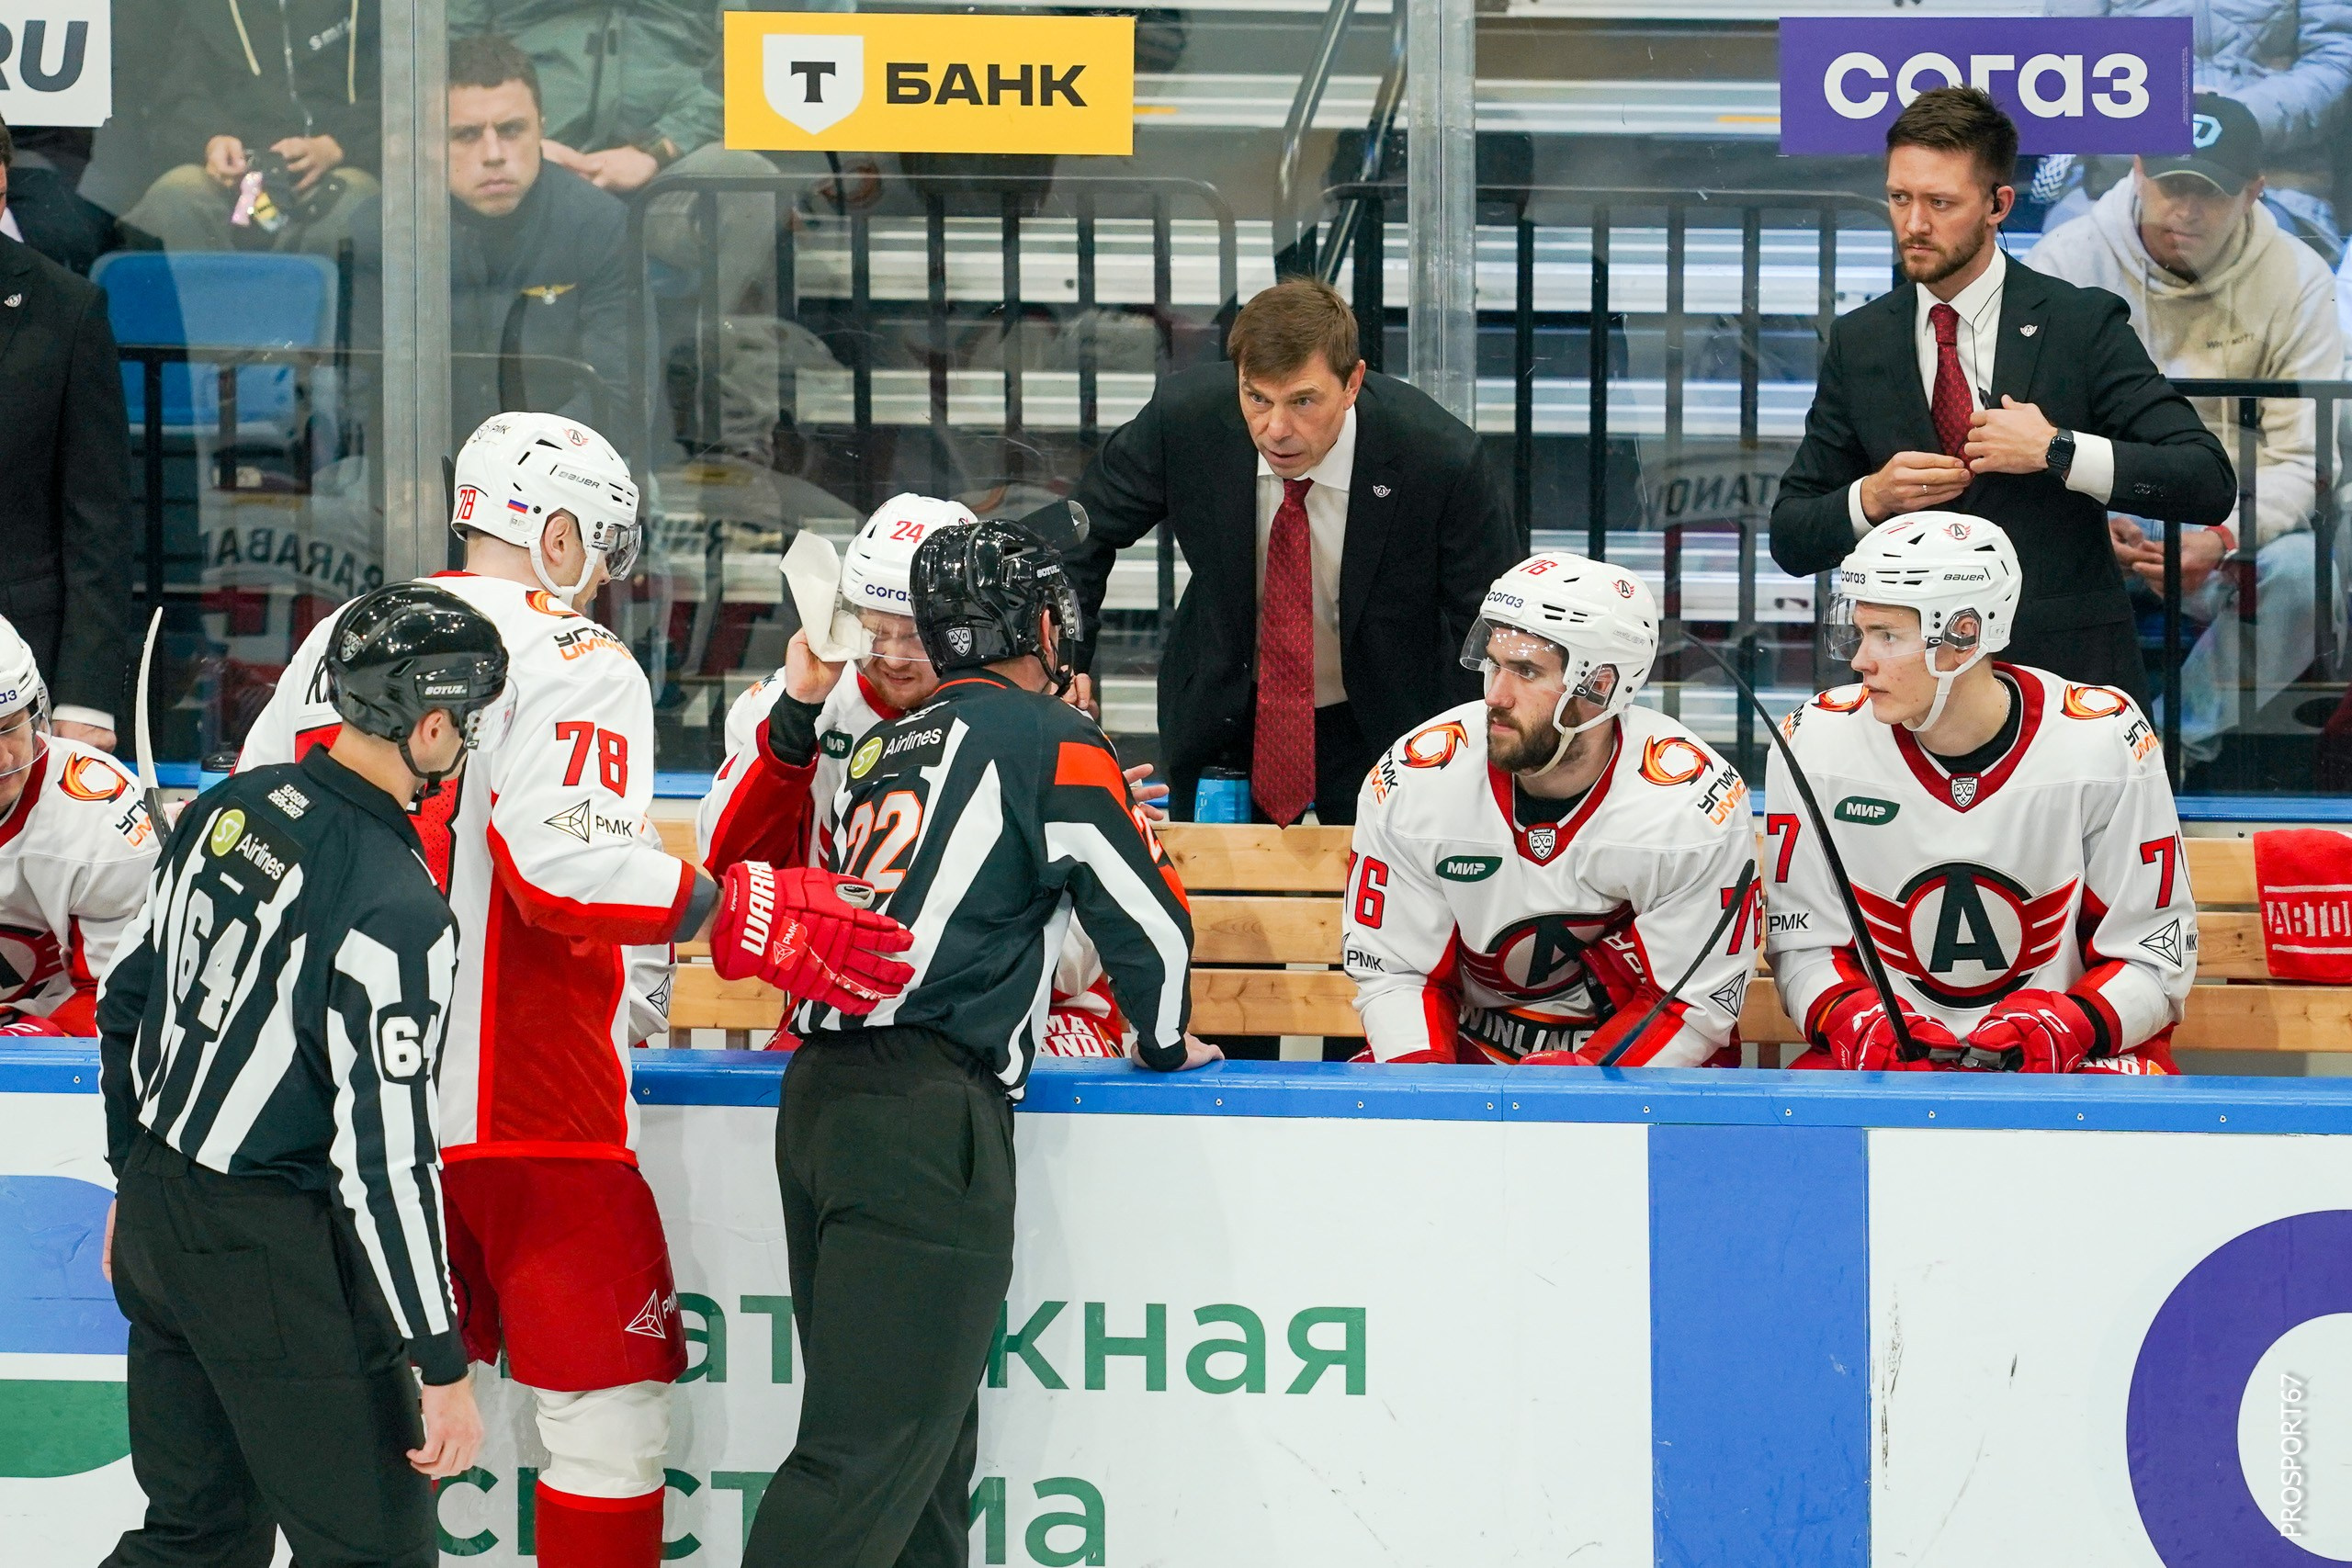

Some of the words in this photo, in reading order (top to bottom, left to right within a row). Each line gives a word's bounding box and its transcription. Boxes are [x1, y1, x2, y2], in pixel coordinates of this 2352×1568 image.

[0, 20, 88, 92] U
[790, 61, 836, 103] Т
[885, 62, 1088, 107] БАНК
[456, 489, 477, 520] 78
[889, 520, 925, 544] 24
[1519, 558, 1558, 576] 76
[1487, 591, 1524, 609] согаз
[555, 720, 628, 798] 78
[882, 728, 943, 760] Airlines
[279, 784, 311, 809] SEASON
[1697, 764, 1739, 815] УГМК
[1846, 801, 1886, 818] МИР
[595, 815, 634, 839] РМК
[844, 789, 924, 894] 22
[234, 832, 294, 881] Airlines
[1767, 813, 1802, 884] 7
[1446, 861, 1487, 875] МИР
[2139, 829, 2185, 909] 7
[782, 920, 799, 945] РМК
[1769, 912, 1809, 932] РМК
[176, 887, 248, 1032] 64
[1346, 949, 1385, 973] РМК
[1458, 1004, 1595, 1058] WINLINE
